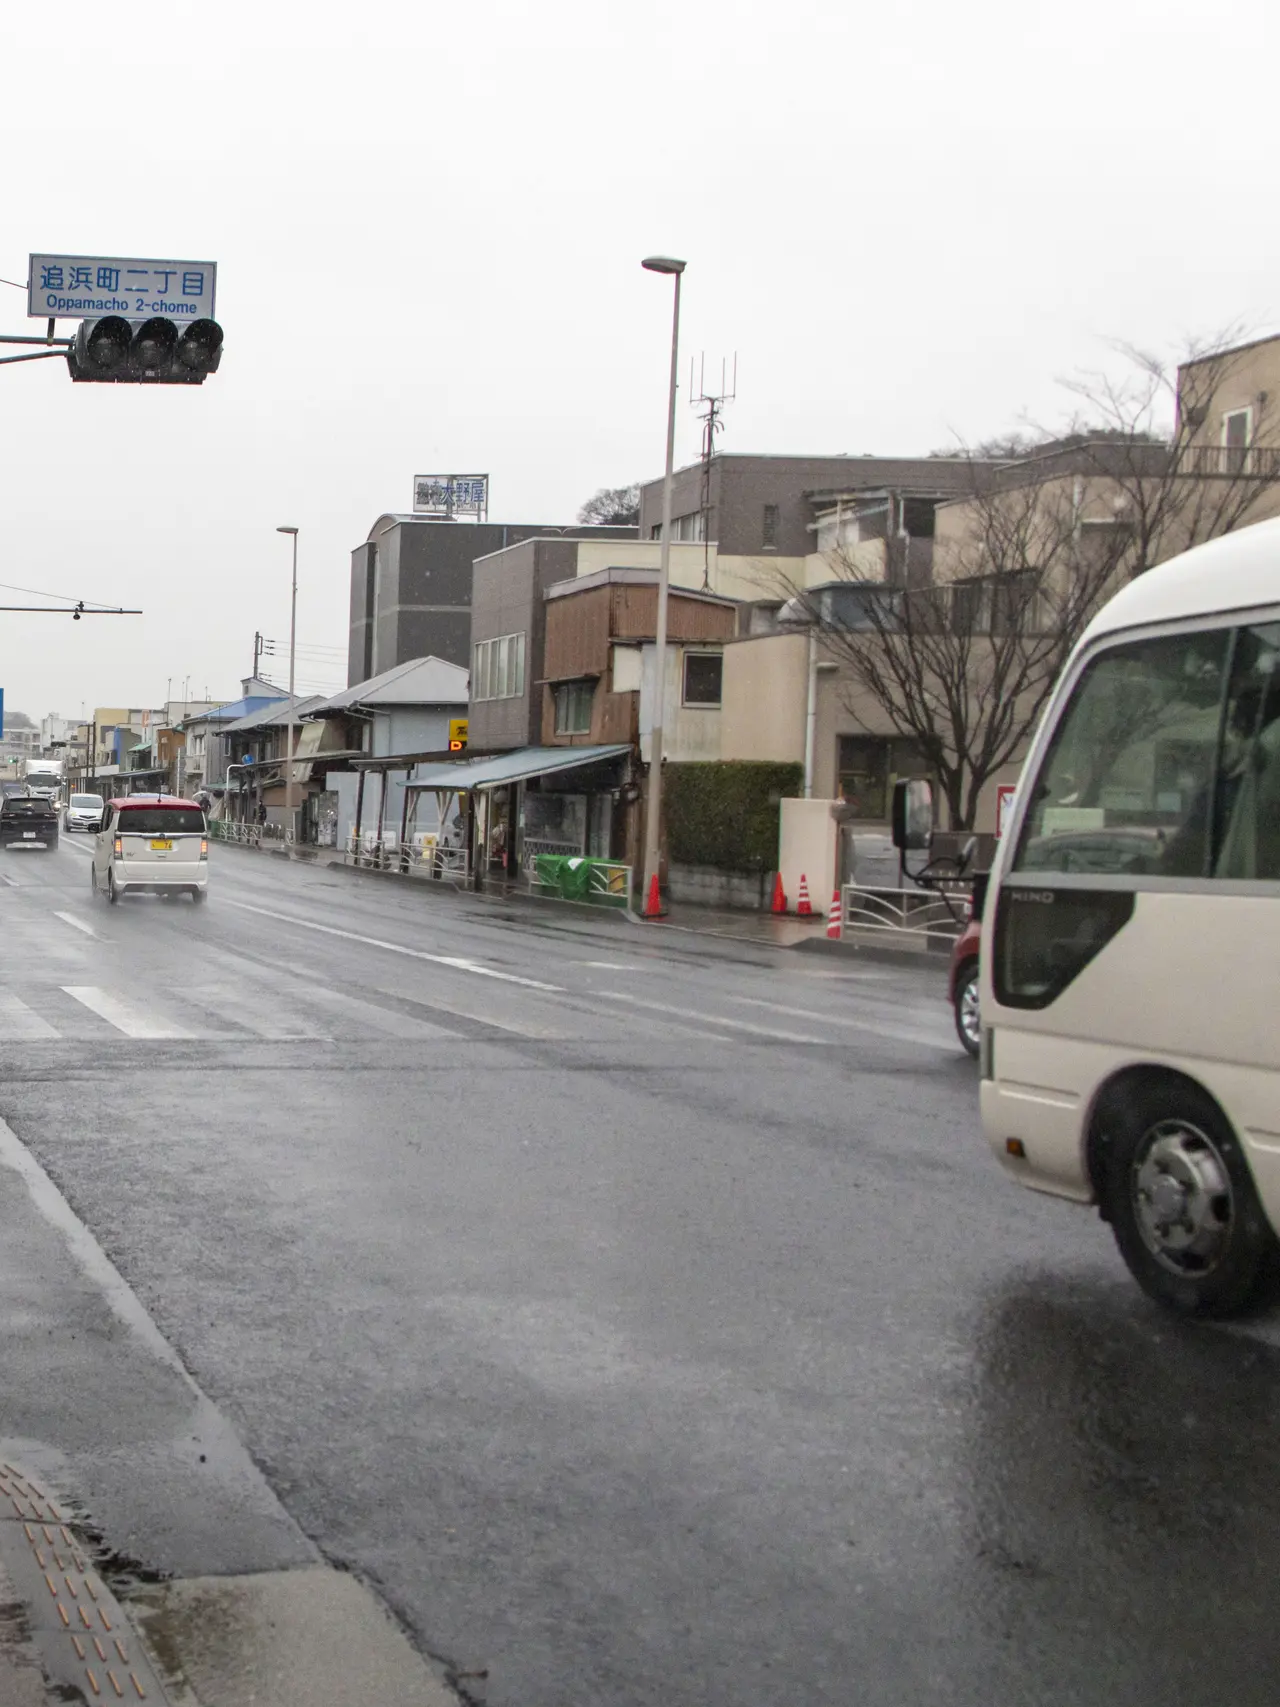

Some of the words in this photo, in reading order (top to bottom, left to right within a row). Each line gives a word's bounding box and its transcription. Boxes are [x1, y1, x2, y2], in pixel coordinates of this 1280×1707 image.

[40, 265, 204, 296] 追浜町二丁目
[47, 294, 128, 311] Oppamacho
[136, 299, 197, 314] 2-chome
[1011, 891, 1055, 904] HINO
